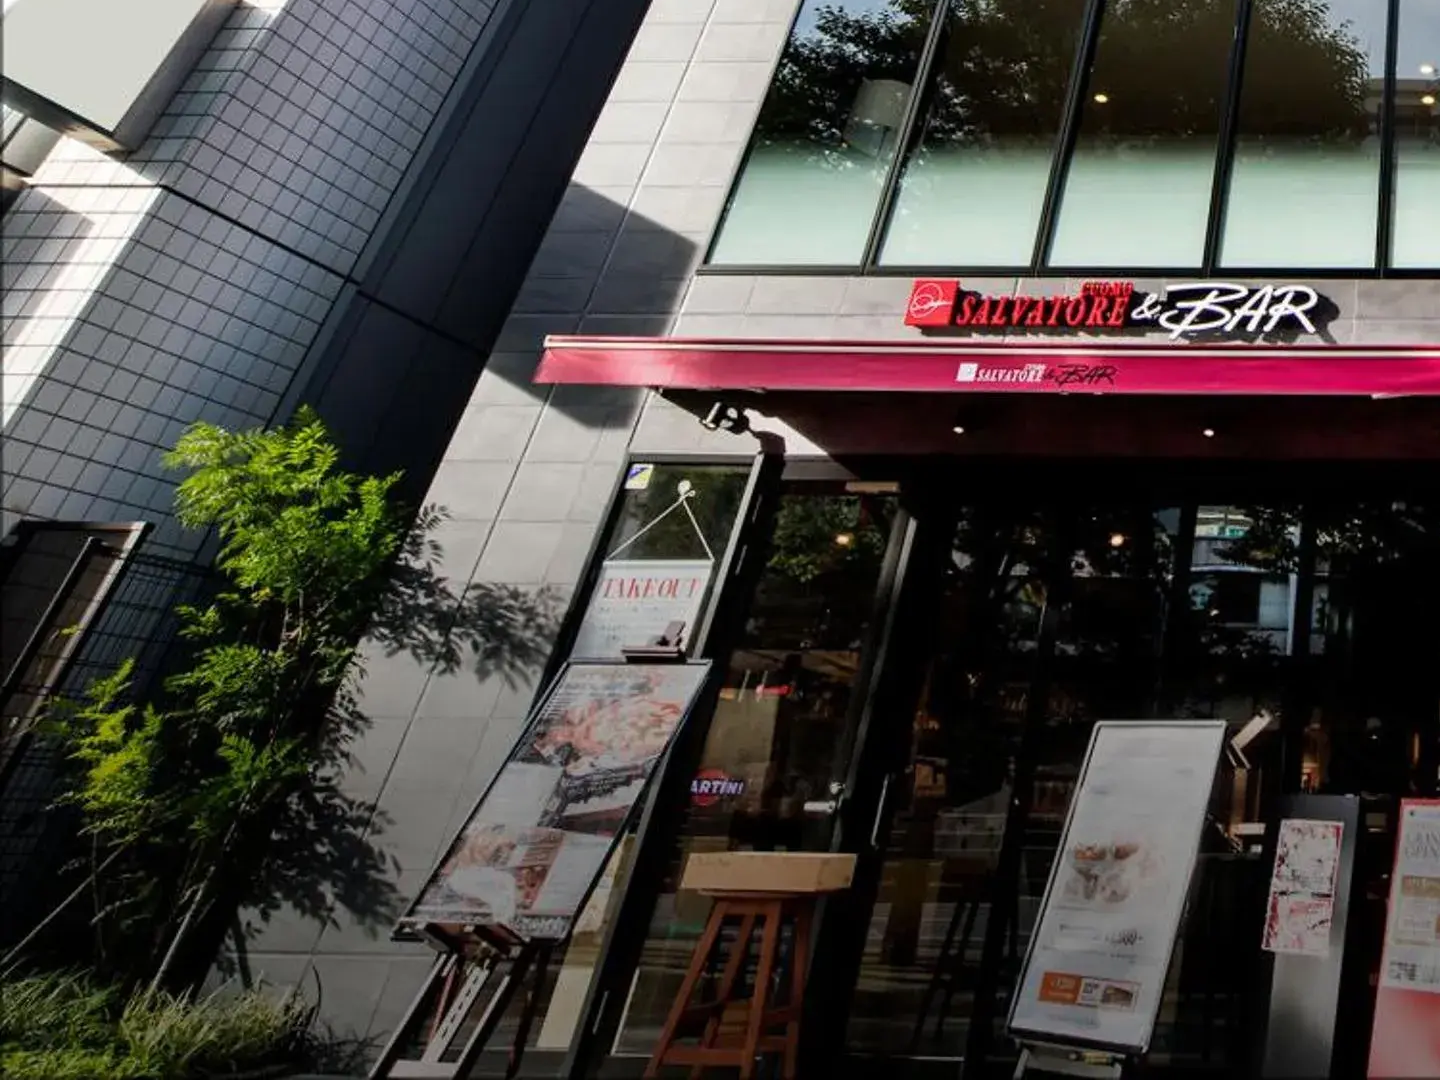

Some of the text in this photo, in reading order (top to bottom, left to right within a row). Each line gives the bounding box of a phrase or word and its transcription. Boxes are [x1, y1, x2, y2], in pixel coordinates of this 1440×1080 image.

[955, 294, 1132, 326] SALVATORE
[1158, 282, 1320, 340] BAR
[690, 778, 745, 795] ARTINI
